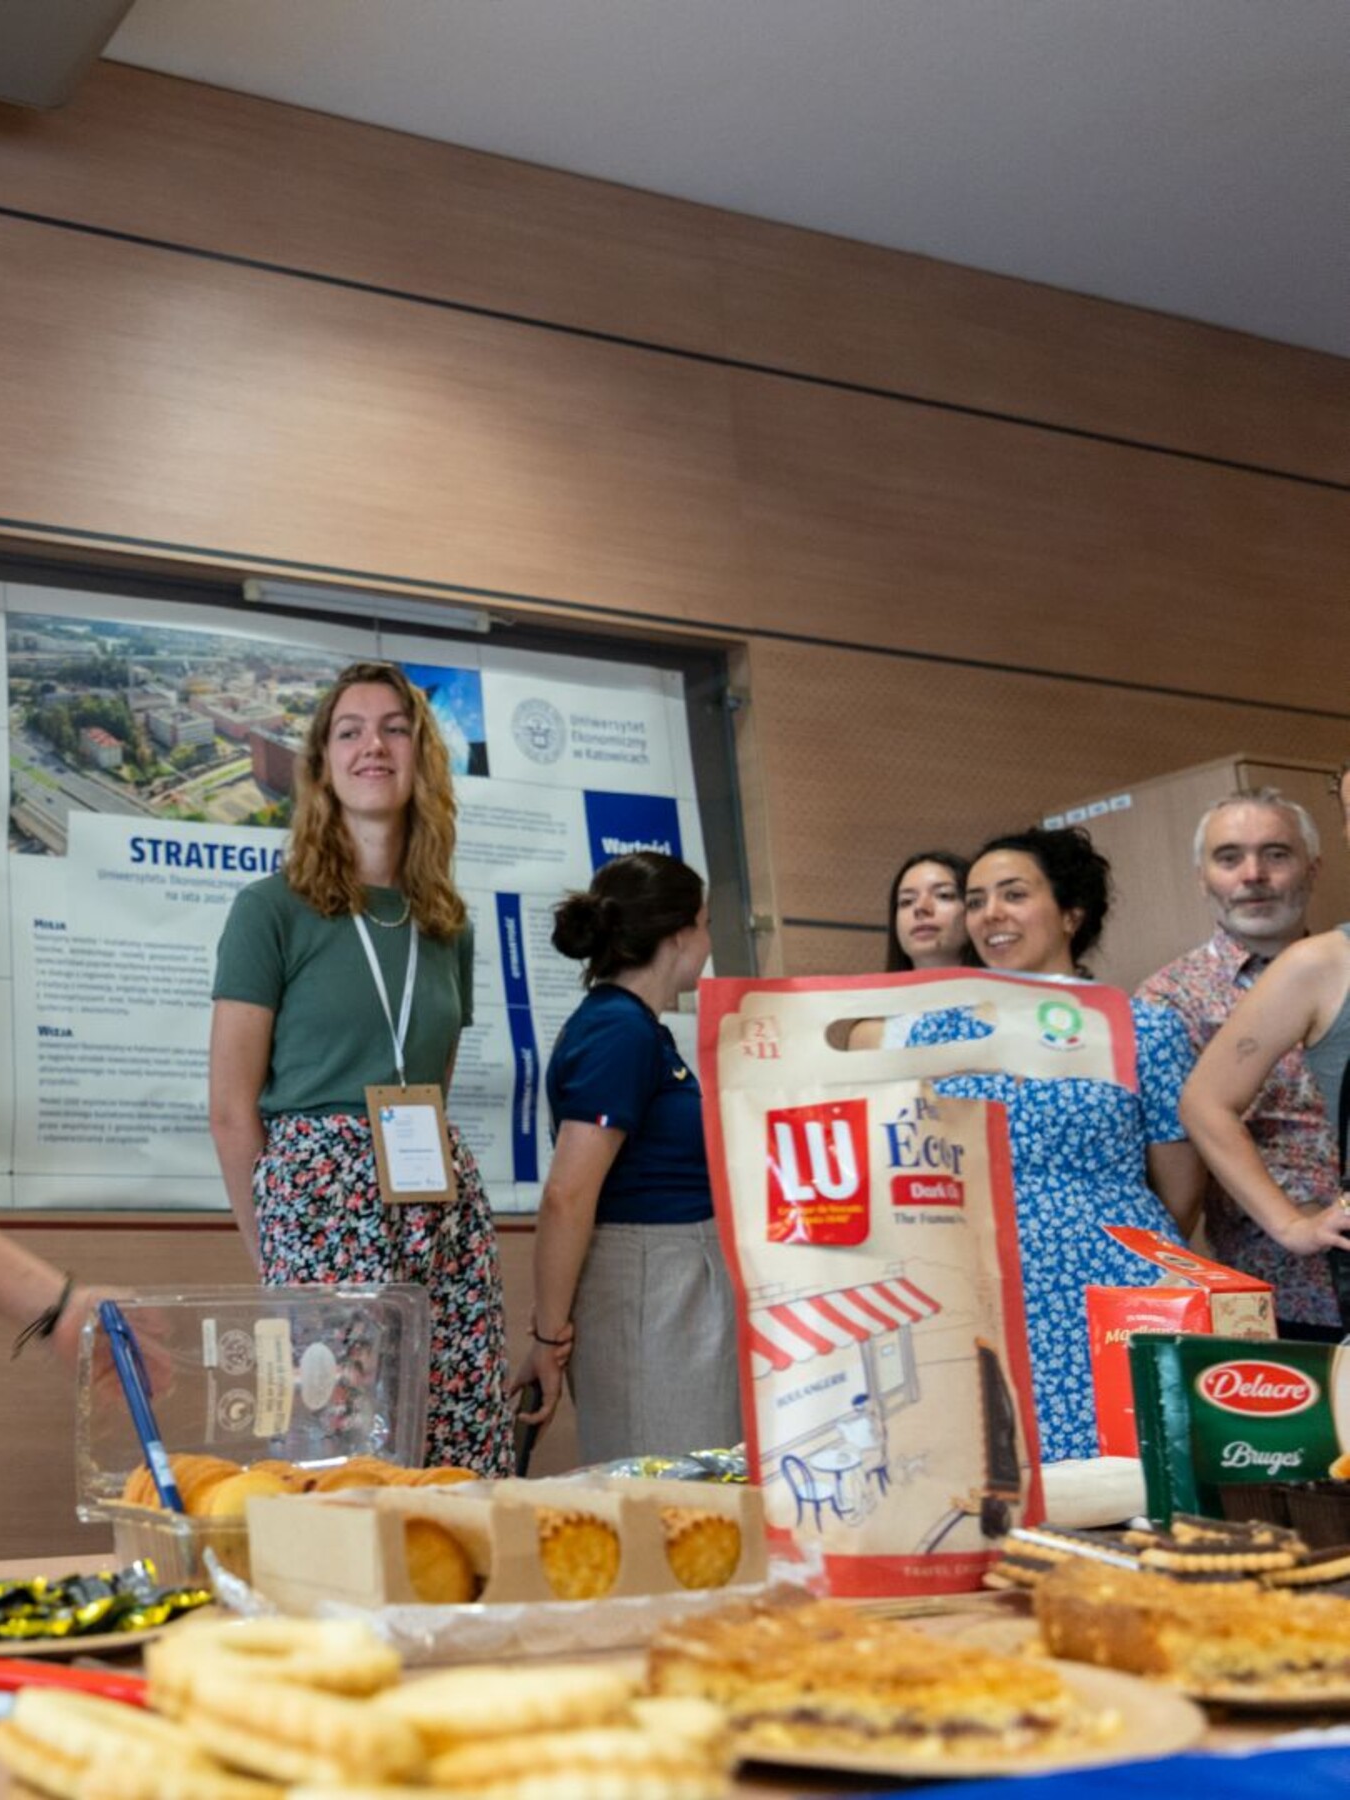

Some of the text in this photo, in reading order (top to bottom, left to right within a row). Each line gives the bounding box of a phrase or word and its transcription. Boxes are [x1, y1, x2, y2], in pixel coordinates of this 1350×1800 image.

[130, 836, 284, 873] STRATEGIA
[771, 1119, 860, 1201] LU
[1208, 1368, 1307, 1400] Delacre
[1220, 1441, 1302, 1476] Bruges
